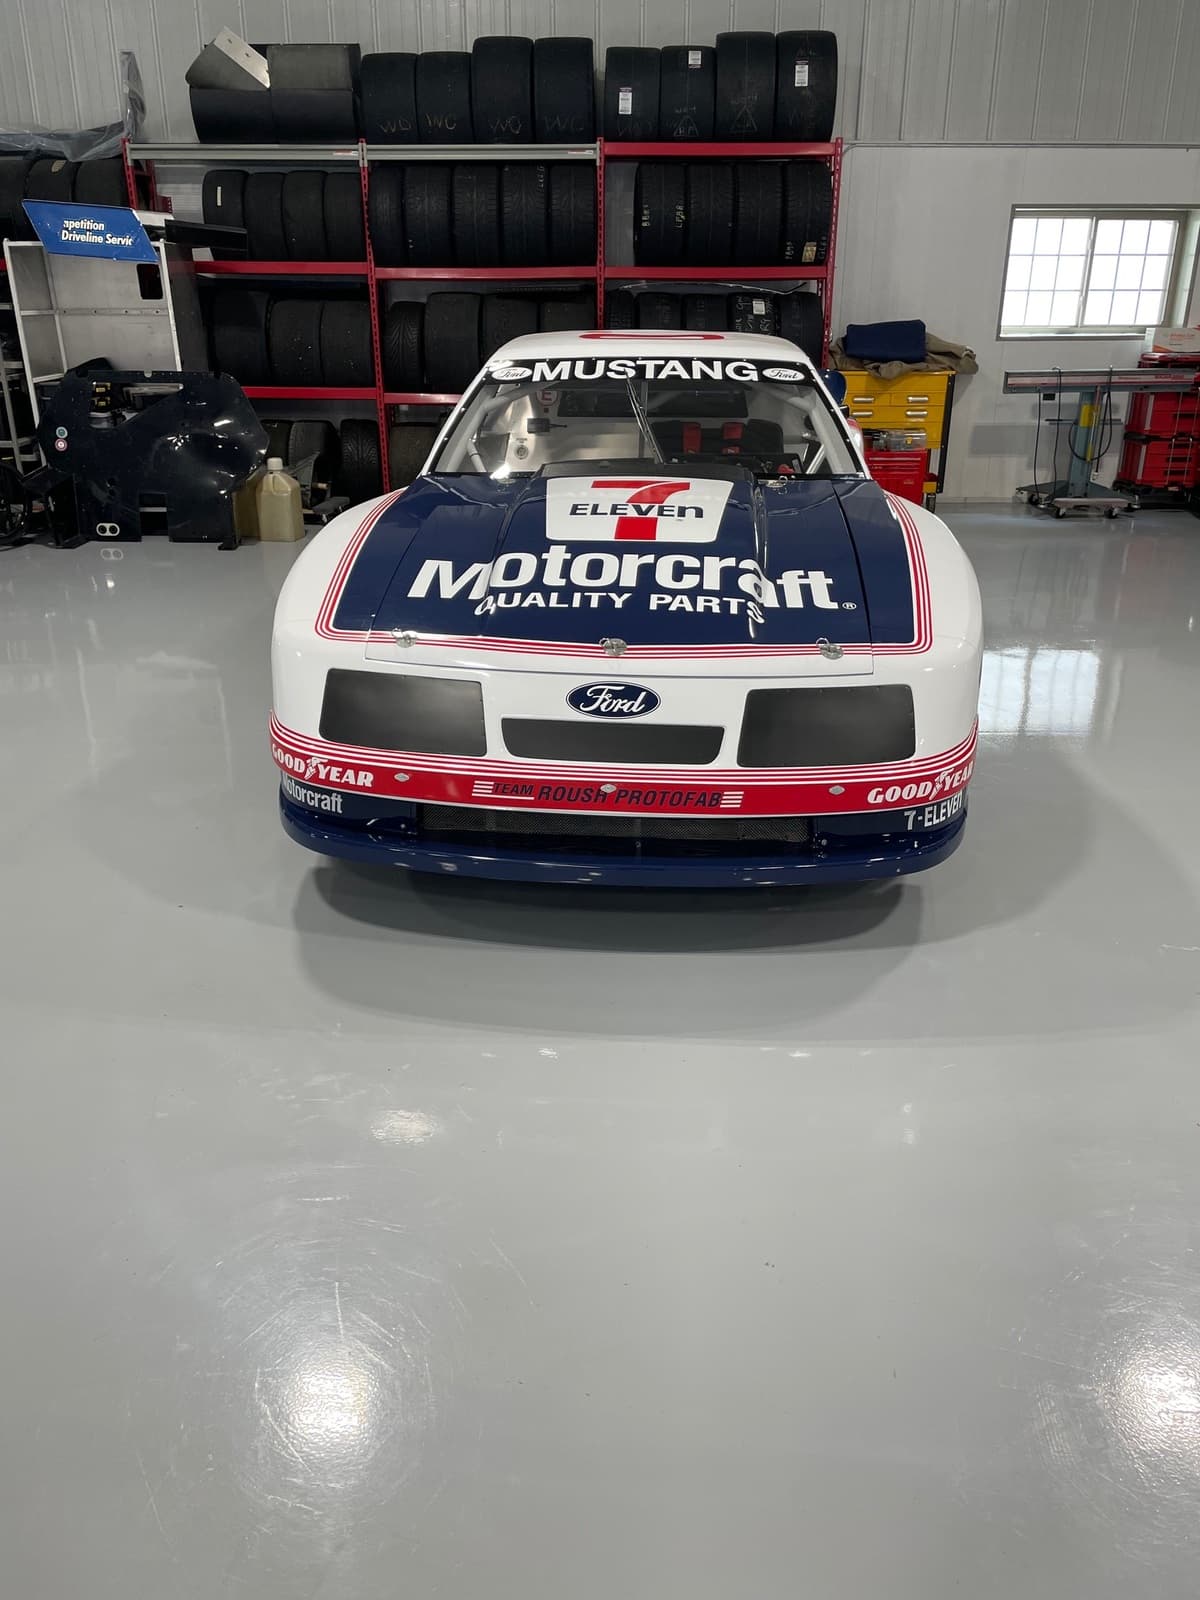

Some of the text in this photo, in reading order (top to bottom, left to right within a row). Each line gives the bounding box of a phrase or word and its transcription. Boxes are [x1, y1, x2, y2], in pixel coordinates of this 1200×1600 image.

[61, 230, 104, 244] Driveline
[531, 359, 759, 382] MUSTANG
[591, 480, 691, 540] 7
[474, 591, 765, 624] QUALITY PARTS
[579, 685, 647, 712] Ford
[493, 783, 723, 808] TEAM ROUSH PROTOFAB
